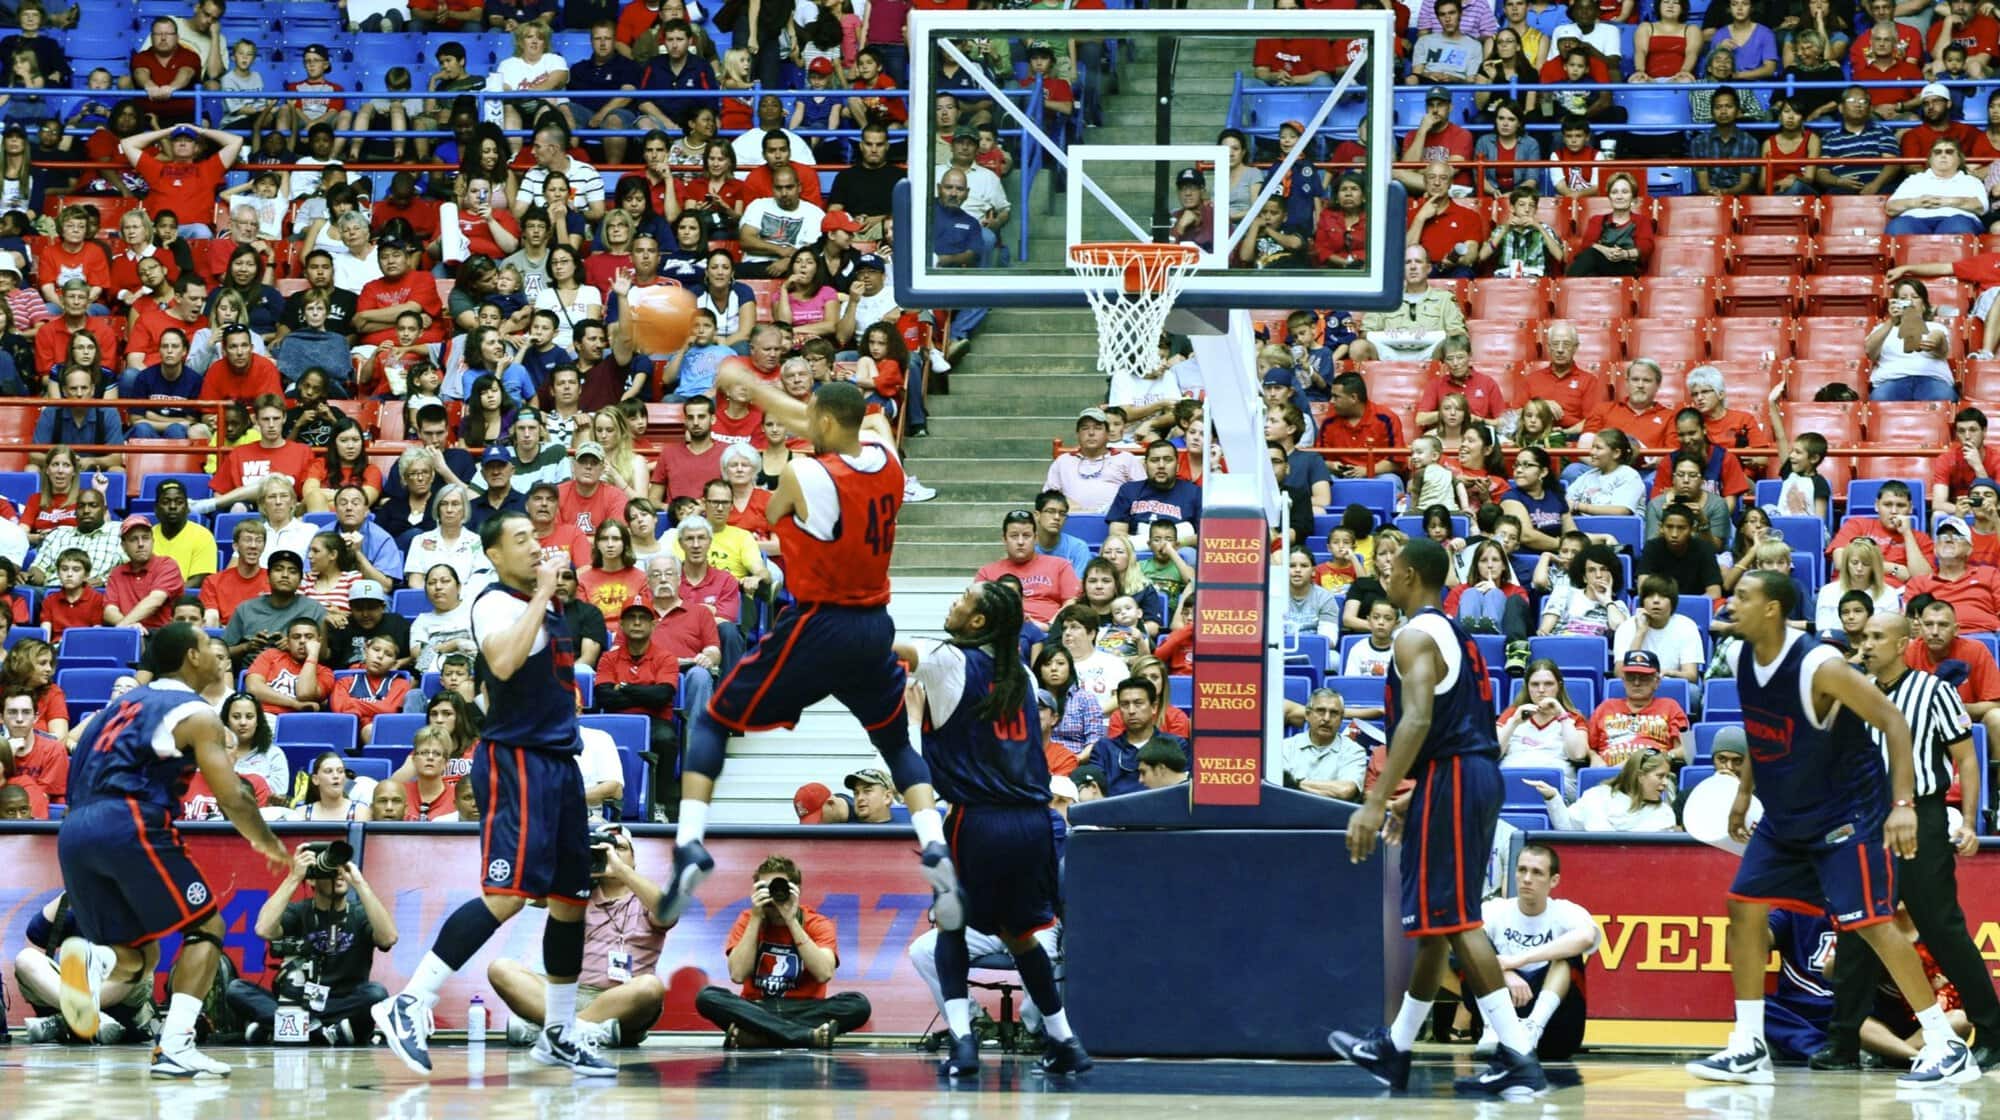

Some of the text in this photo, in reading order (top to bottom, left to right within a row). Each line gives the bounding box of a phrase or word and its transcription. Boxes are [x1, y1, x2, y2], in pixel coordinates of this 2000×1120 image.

[243, 460, 271, 477] WE
[1131, 499, 1182, 521] ARIZONA
[577, 512, 594, 533] A
[865, 494, 896, 556] 42
[1203, 538, 1261, 550] WELLS
[1203, 551, 1260, 564] FARGO
[364, 584, 373, 596] P
[1200, 609, 1258, 622] WELLS
[1201, 623, 1257, 636] FARGO
[1199, 683, 1257, 696] WELLS
[1199, 697, 1256, 710] FARGO
[1198, 758, 1257, 770] WELLS
[1199, 772, 1255, 785] FARGO
[1503, 927, 1554, 948] ARIZOA
[279, 1015, 300, 1037] A
